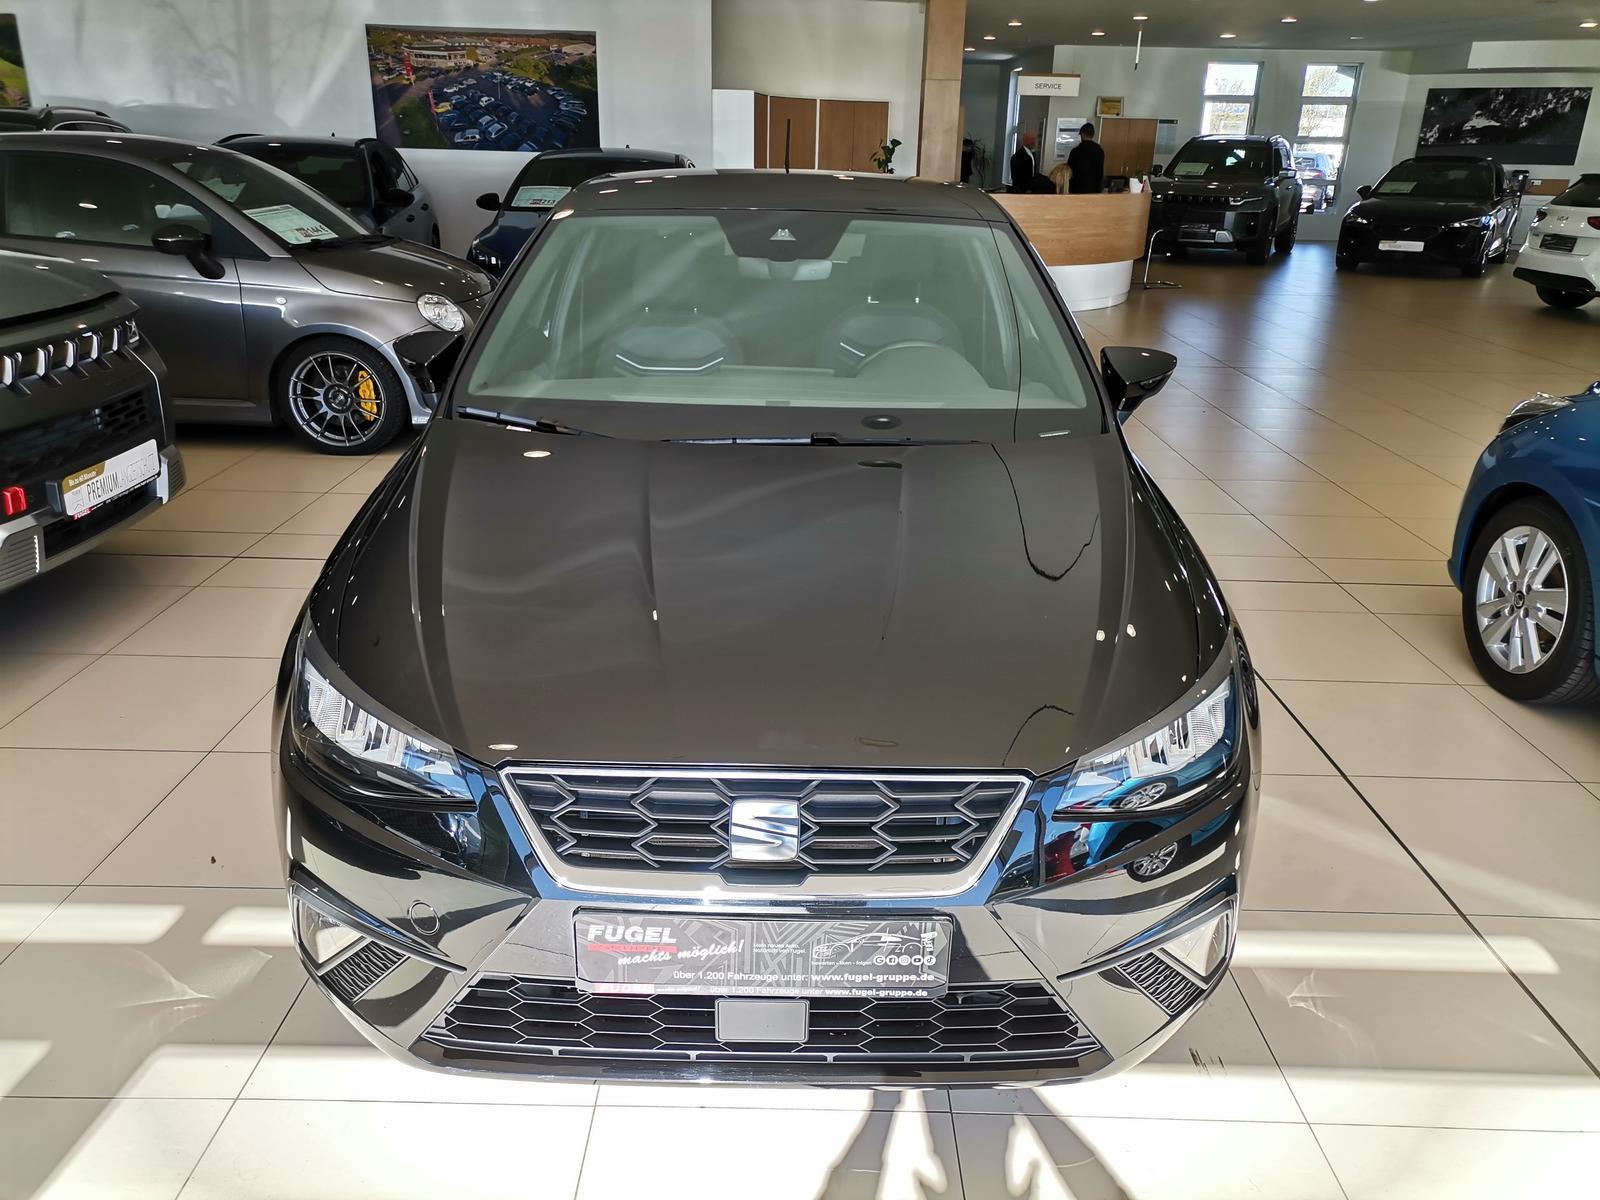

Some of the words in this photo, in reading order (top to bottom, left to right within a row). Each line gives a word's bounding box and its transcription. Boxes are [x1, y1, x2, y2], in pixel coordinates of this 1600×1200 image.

[1034, 82, 1062, 90] SERVICE
[86, 472, 120, 502] PREMIUM
[587, 924, 677, 944] FUGEL
[677, 939, 745, 961] möglich!
[673, 970, 696, 980] über
[699, 971, 725, 980] 1.200
[727, 971, 779, 983] Fahrzeuge
[810, 972, 935, 983] www.fugel-gruppe.de
[732, 986, 754, 994] 1.200
[756, 986, 800, 996] Fahrzeuge
[825, 987, 928, 998] www.fugel-gruppe.de
